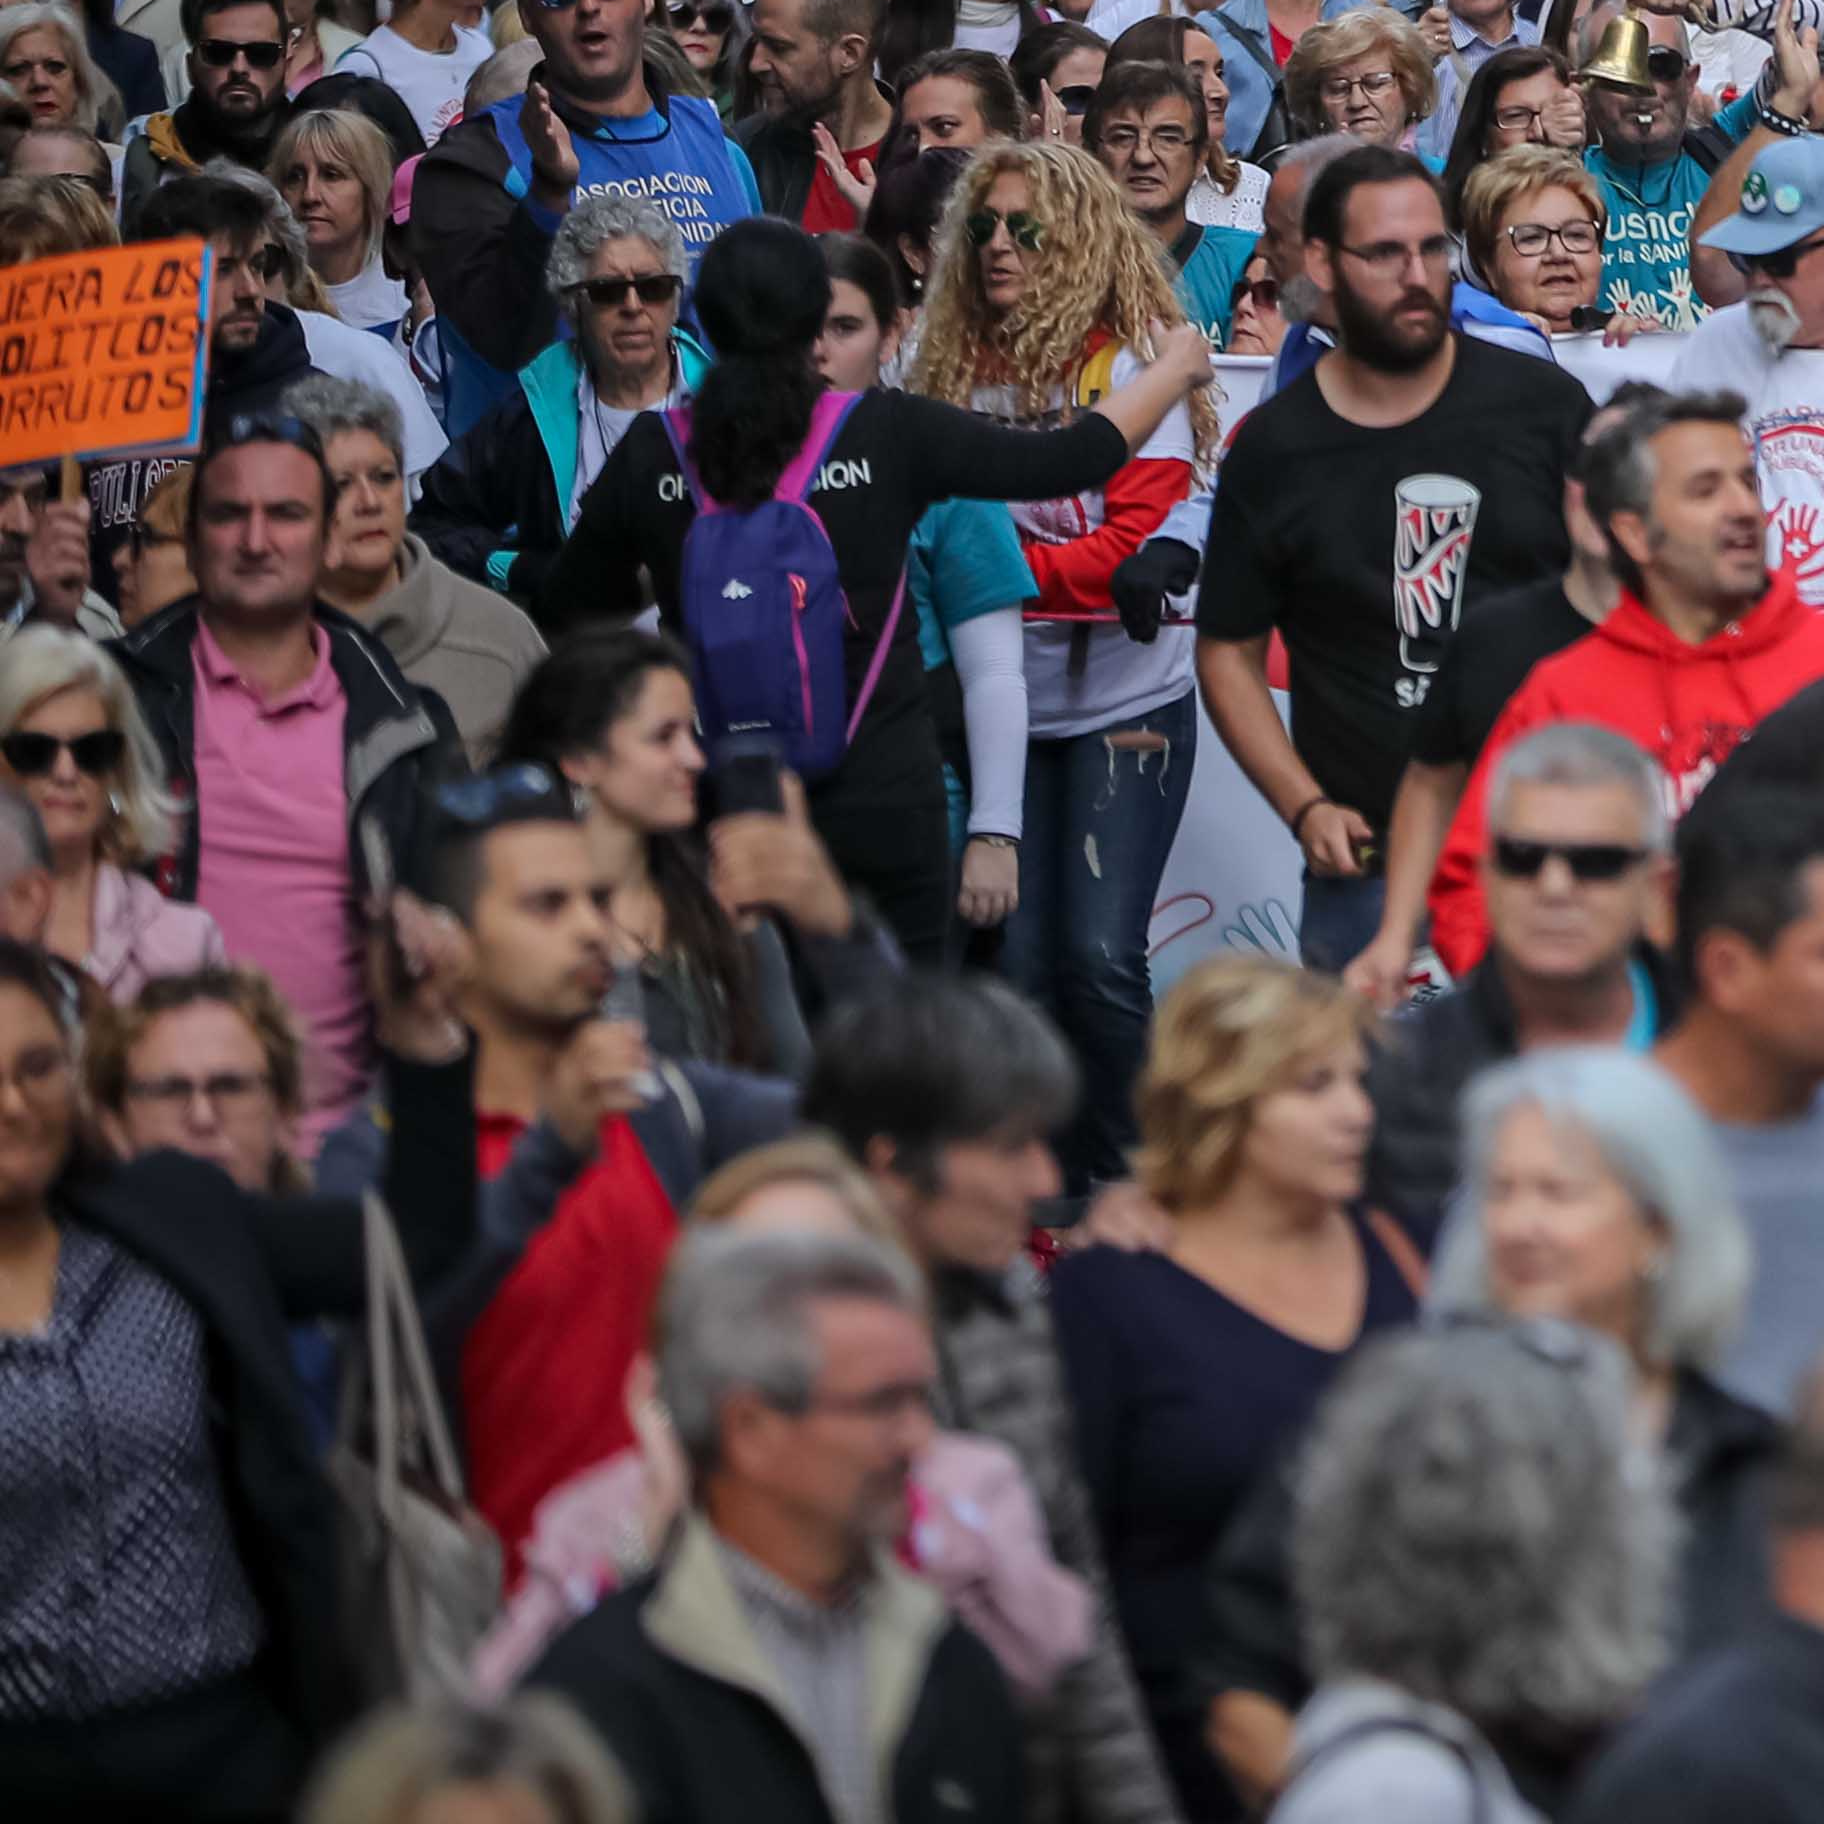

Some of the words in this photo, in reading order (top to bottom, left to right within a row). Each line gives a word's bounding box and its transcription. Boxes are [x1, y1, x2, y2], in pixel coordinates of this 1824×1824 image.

[123, 257, 202, 305] LOS
[0, 307, 205, 377] OLITCOS
[0, 366, 190, 434] RRUTOS
